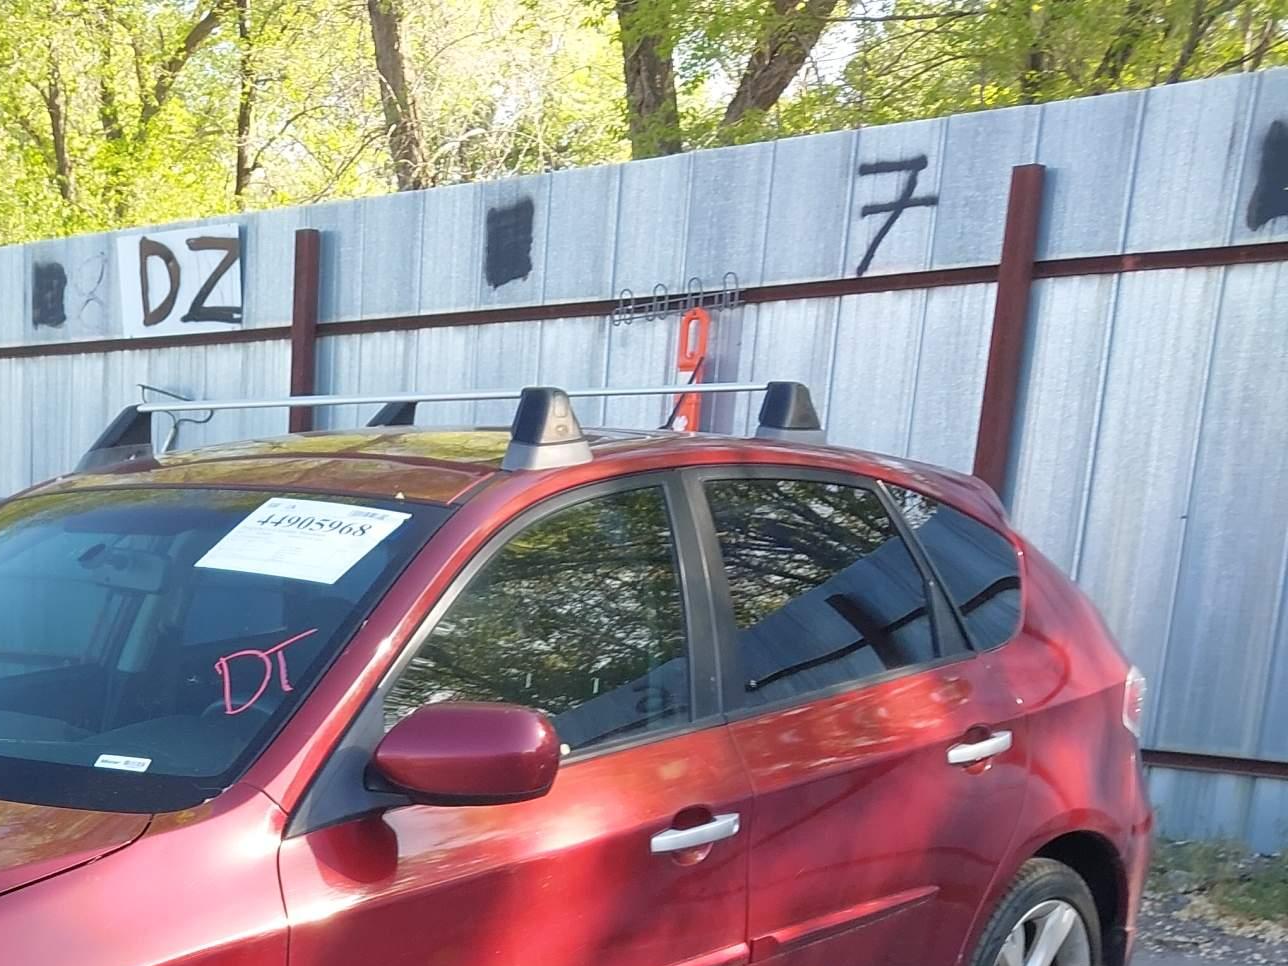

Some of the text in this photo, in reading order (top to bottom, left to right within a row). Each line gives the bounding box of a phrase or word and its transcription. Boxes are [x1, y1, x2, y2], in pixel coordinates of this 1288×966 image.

[857, 154, 940, 277] 7
[138, 235, 243, 327] DZ
[257, 513, 373, 537] 44905968
